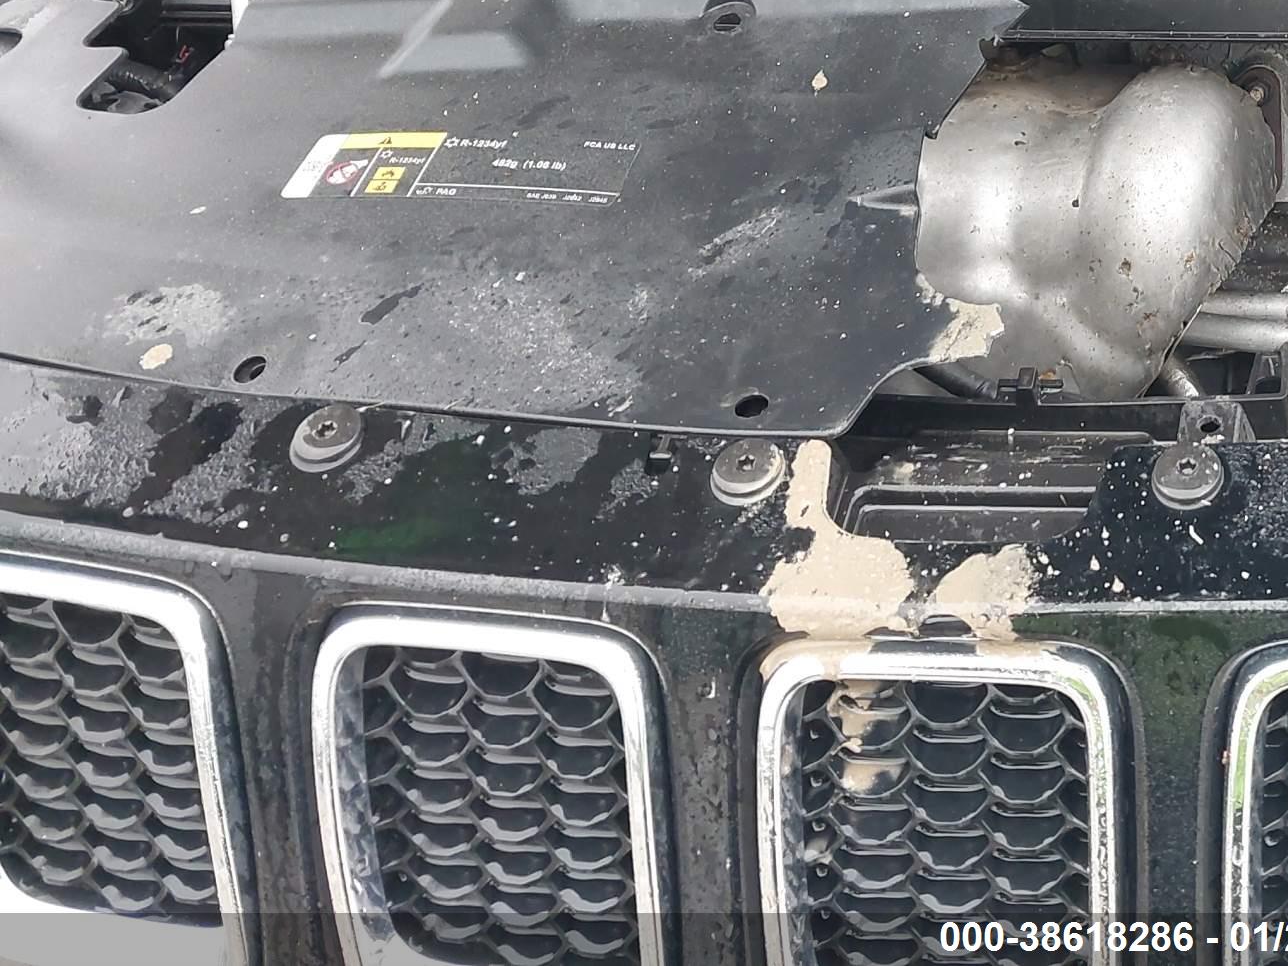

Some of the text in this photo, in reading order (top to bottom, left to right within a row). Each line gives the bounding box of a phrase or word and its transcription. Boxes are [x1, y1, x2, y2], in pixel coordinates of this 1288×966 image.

[460, 139, 508, 150] R-1234yf
[583, 141, 602, 149] FCA
[618, 143, 636, 151] LLC
